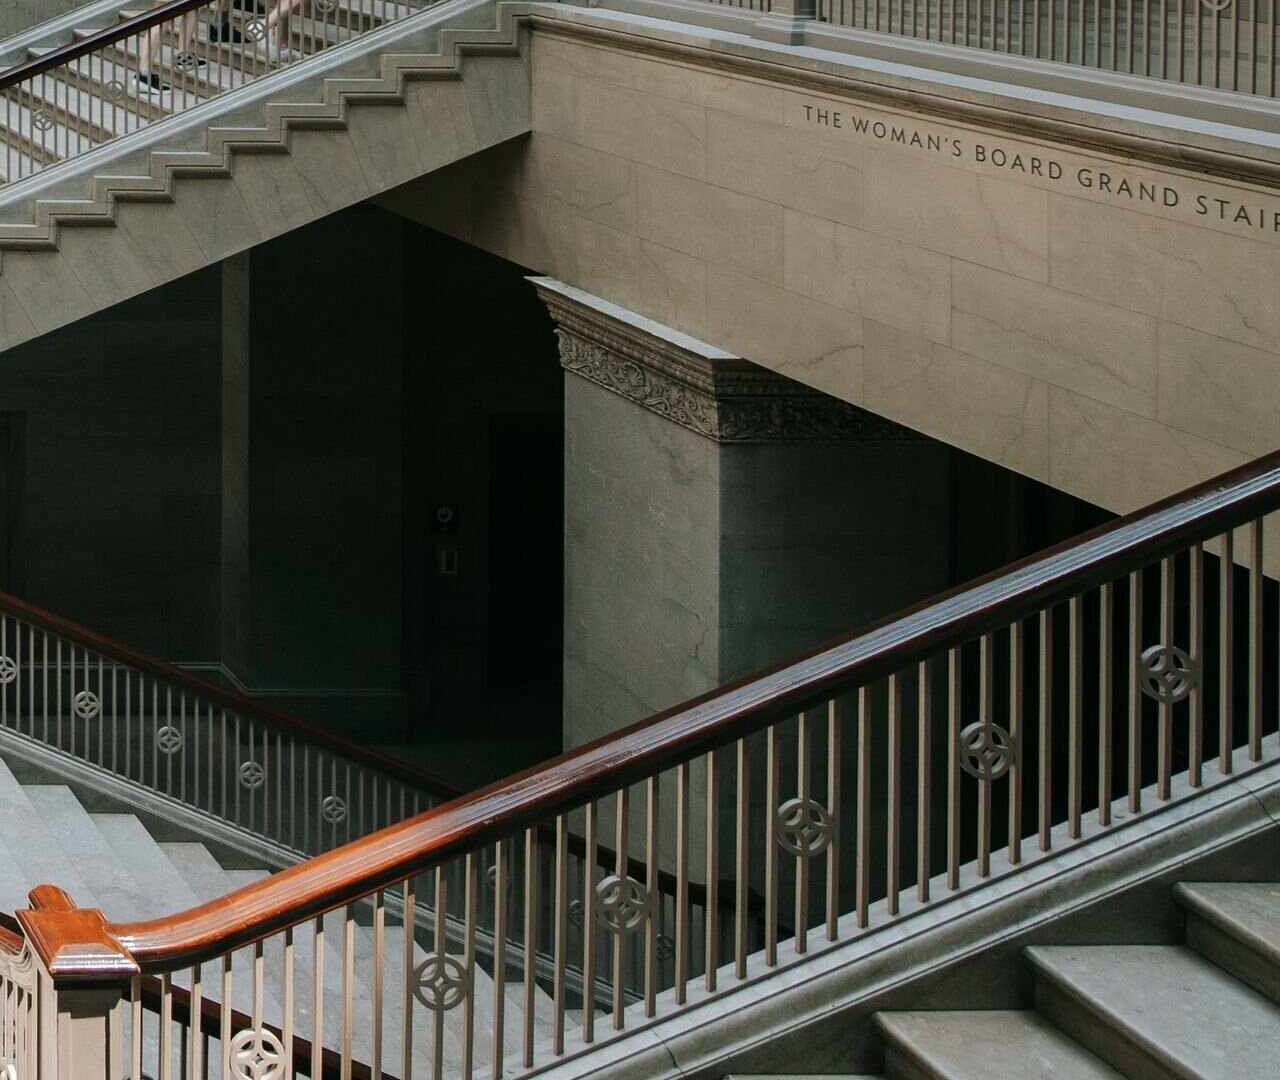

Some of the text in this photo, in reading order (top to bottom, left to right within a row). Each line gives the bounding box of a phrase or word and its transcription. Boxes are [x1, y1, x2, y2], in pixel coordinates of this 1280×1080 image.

[802, 105, 842, 129] THE
[852, 116, 963, 157] WOMAN'S
[975, 144, 1063, 180] BOARD
[1077, 168, 1179, 208] GRAND
